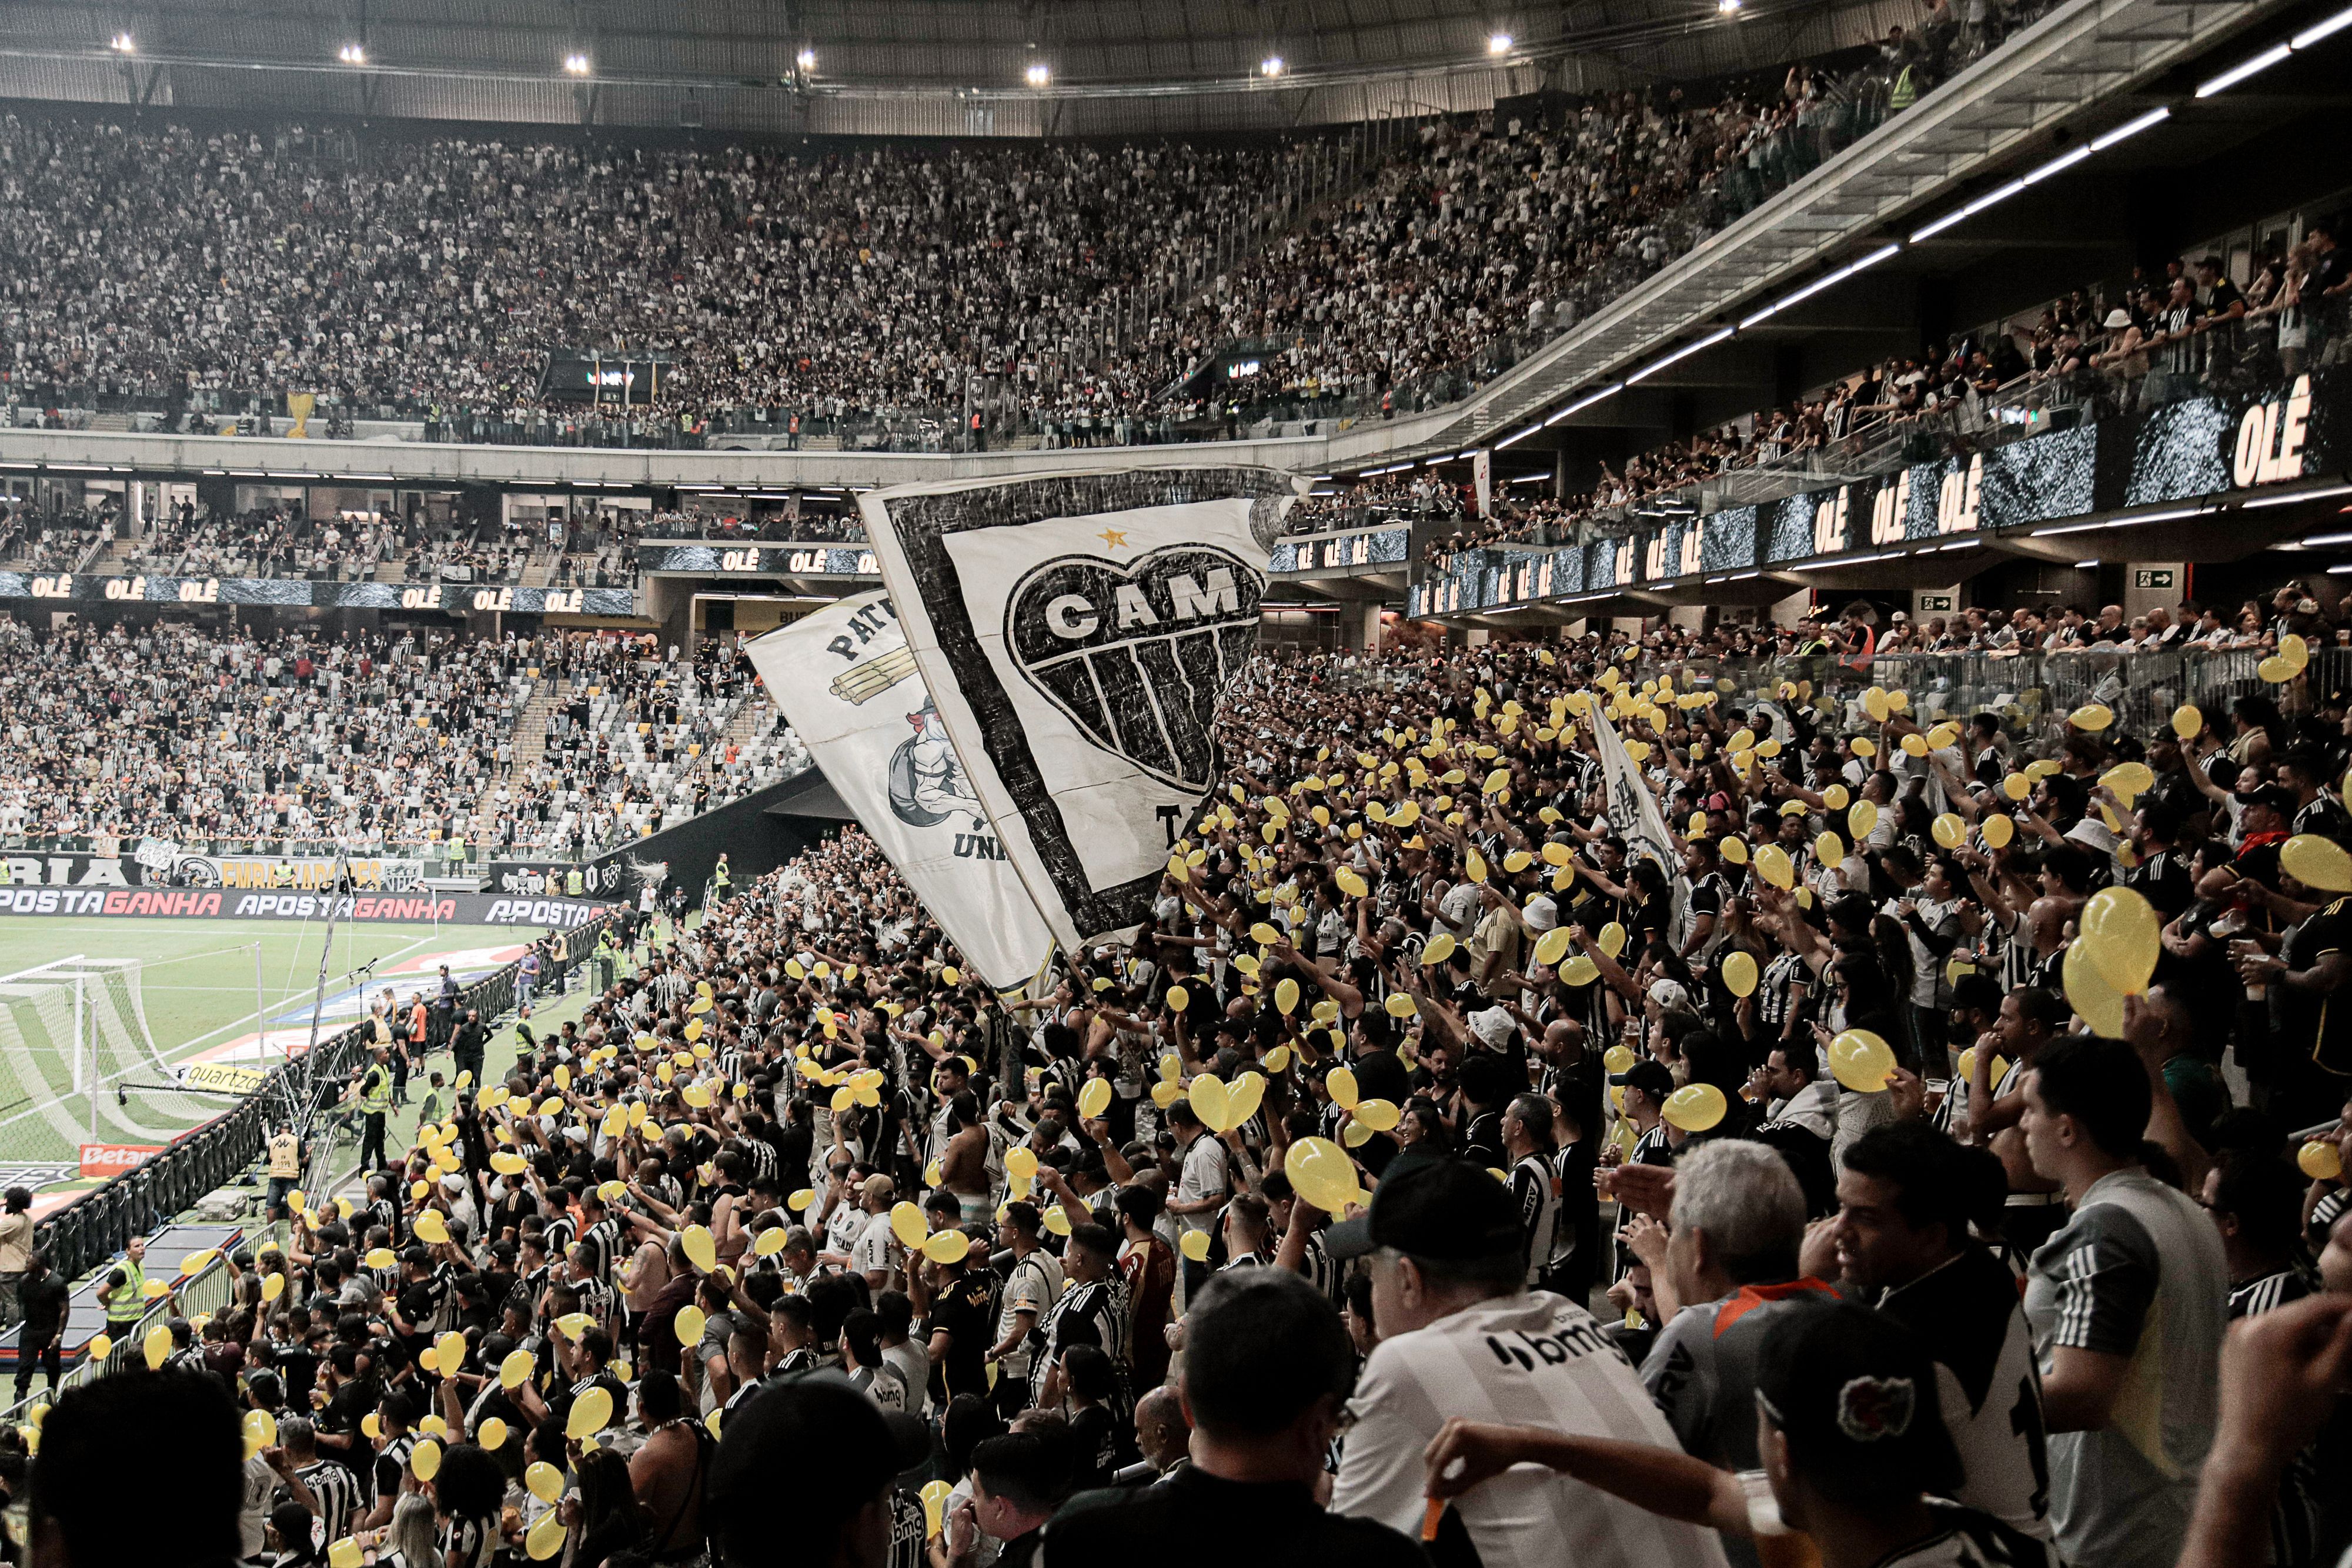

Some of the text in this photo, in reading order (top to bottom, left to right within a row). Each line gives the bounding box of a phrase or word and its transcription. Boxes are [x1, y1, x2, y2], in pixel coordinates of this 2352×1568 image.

[2234, 374, 2310, 487] OLÊ
[1815, 452, 1982, 554] OLÊ OLÊ OLÊ
[723, 547, 759, 571] OLÊ
[790, 549, 826, 573] OLÊ
[31, 574, 219, 602] OLÊ OLÊ OLÊ
[402, 585, 583, 613] OLÊ OLÊ OLÊ
[1045, 567, 1239, 640] CAM
[953, 833, 1009, 861] UNI
[189, 1066, 262, 1091] quartzo
[893, 1516, 924, 1542] bmg
